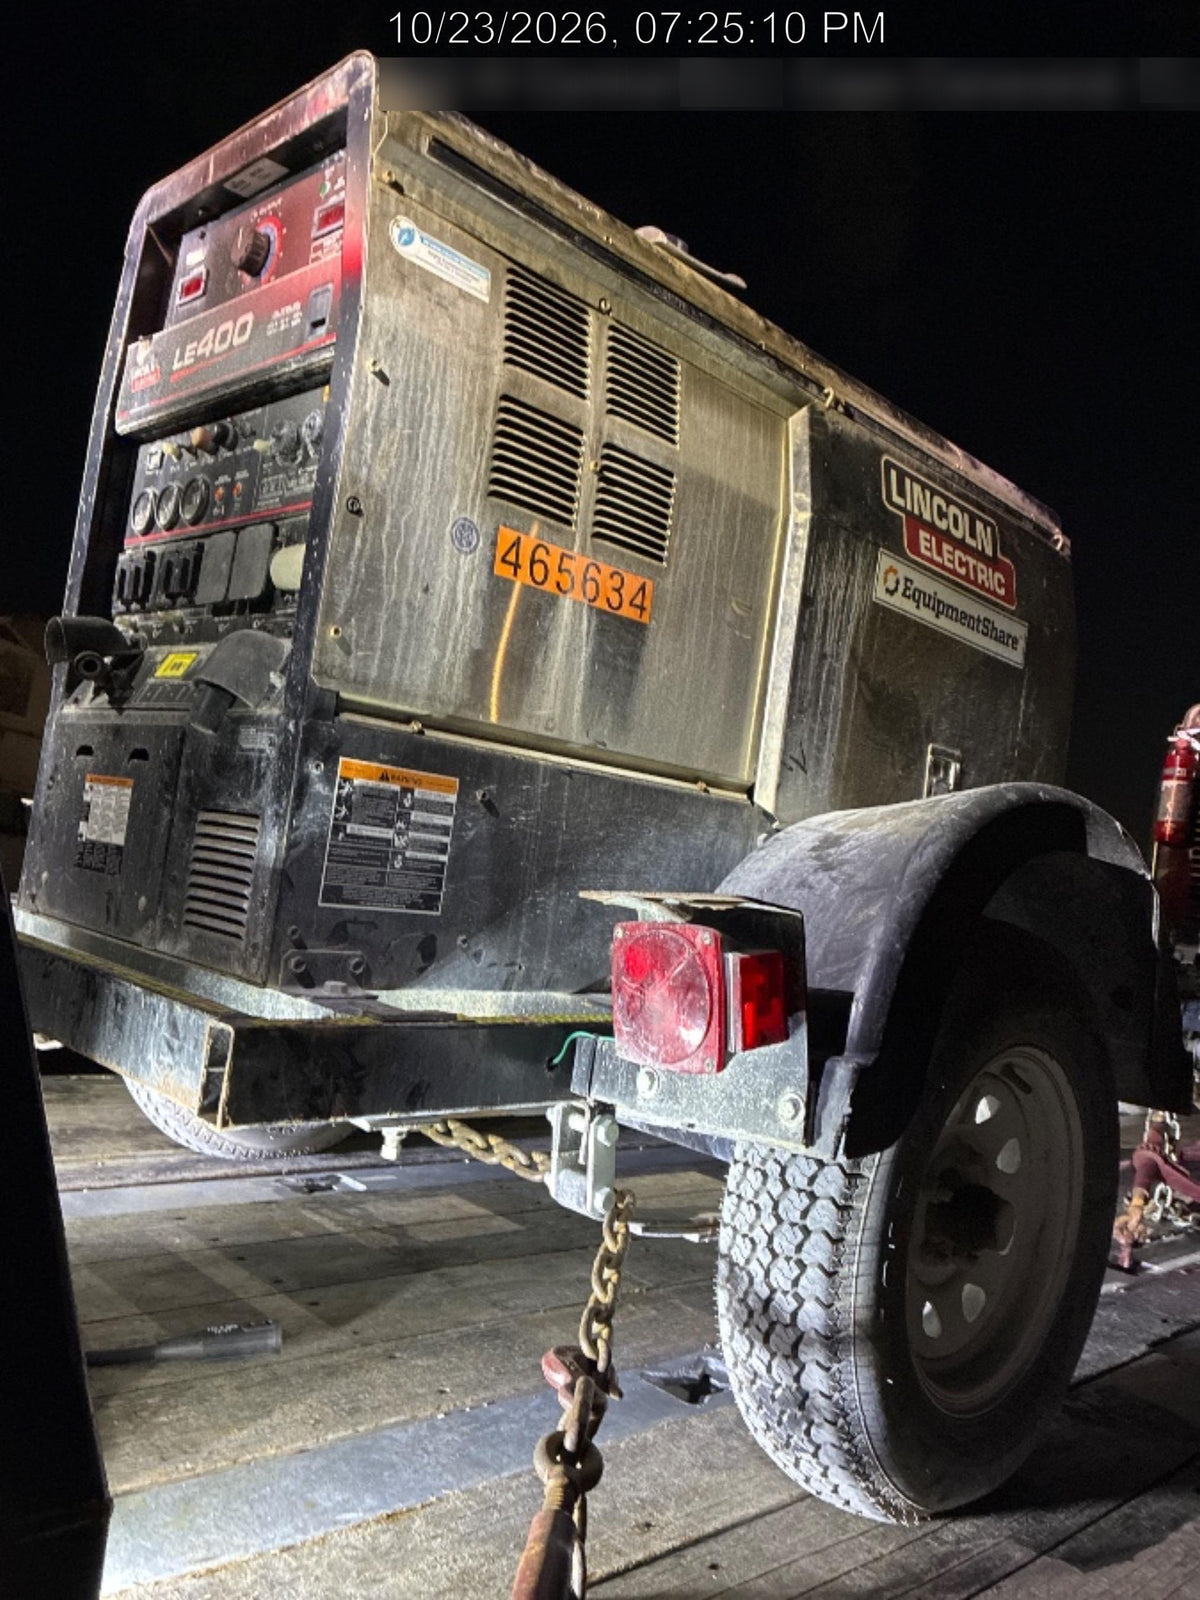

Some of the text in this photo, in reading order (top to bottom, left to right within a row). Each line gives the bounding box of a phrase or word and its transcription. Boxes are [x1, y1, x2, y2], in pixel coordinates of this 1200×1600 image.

[172, 311, 254, 371] LE400
[890, 469, 993, 557] LINCOLN
[500, 536, 648, 619] 465634
[919, 530, 1006, 596] ELECTRIC
[901, 577, 1019, 650] EquipmentShare
